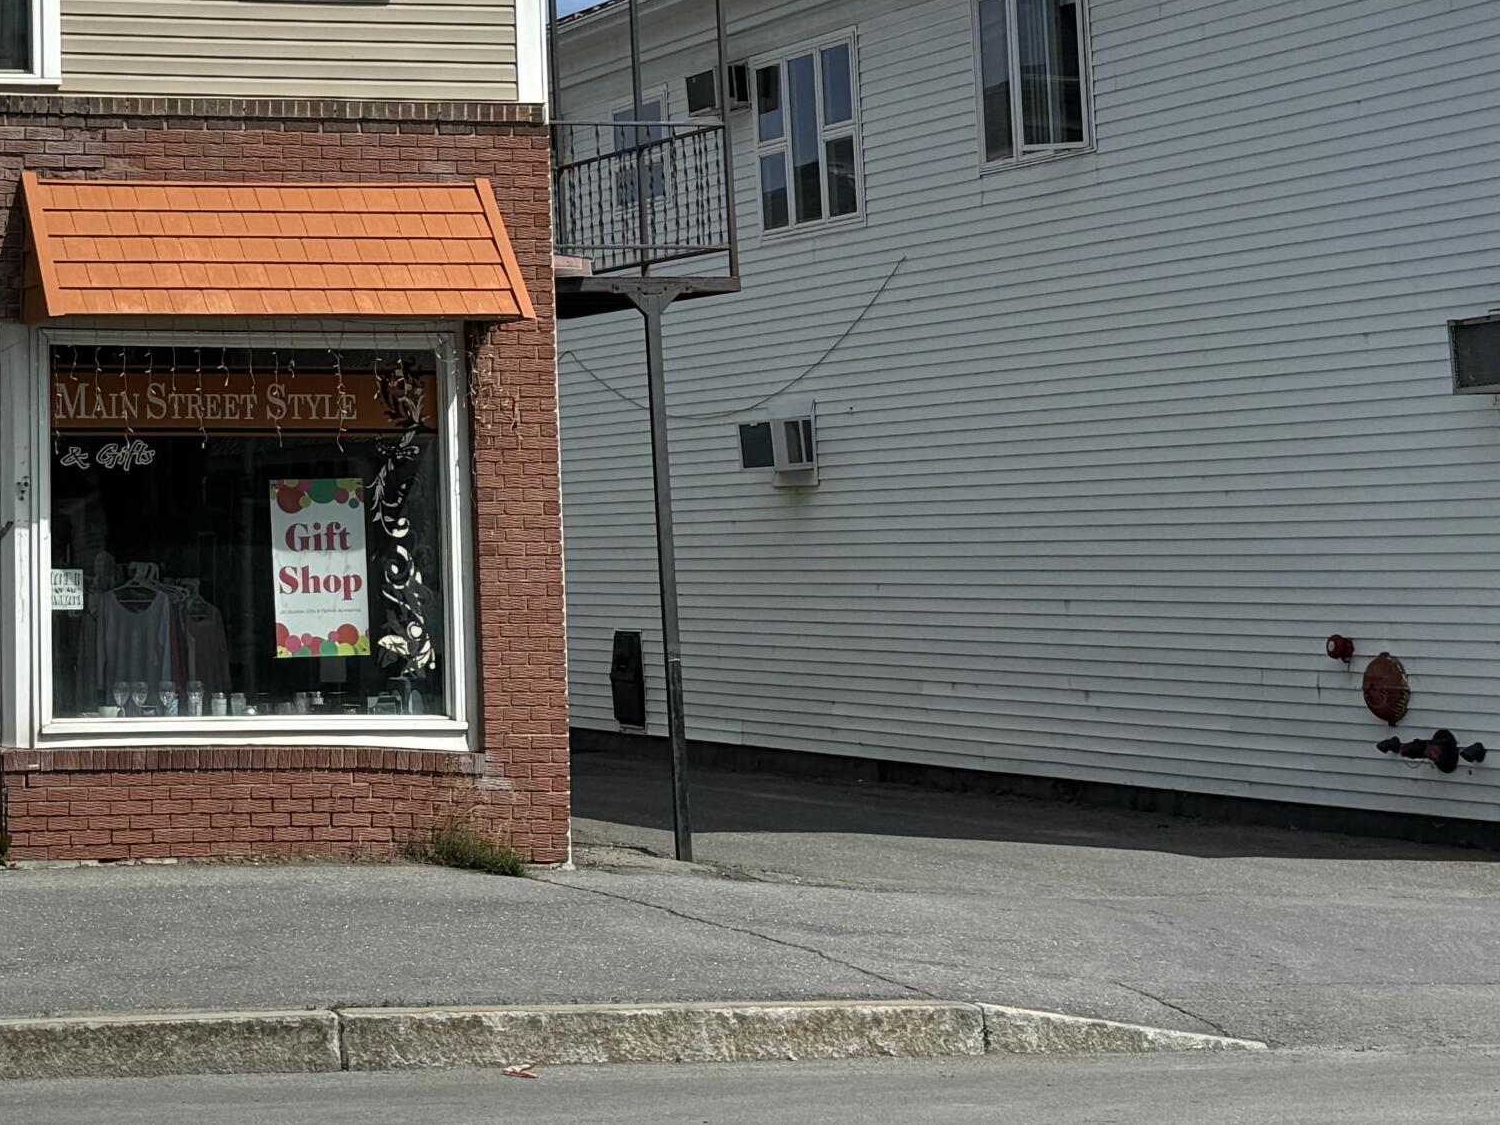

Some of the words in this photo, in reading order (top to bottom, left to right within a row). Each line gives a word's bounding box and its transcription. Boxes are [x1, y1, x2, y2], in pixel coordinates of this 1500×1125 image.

[60, 446, 90, 470] &
[96, 439, 156, 472] Gifts
[285, 521, 352, 552] Gift
[278, 565, 363, 601] Shop
